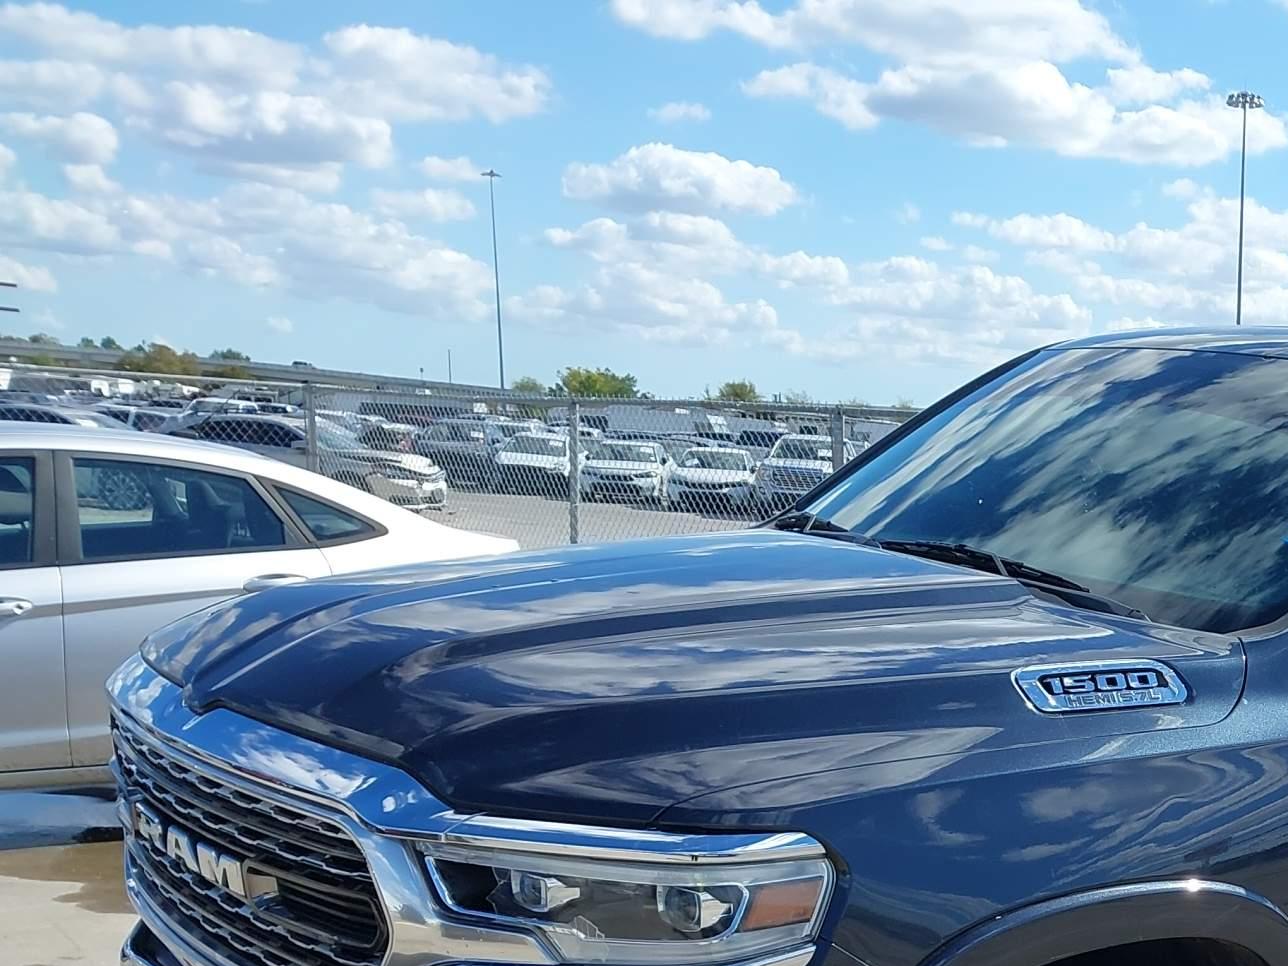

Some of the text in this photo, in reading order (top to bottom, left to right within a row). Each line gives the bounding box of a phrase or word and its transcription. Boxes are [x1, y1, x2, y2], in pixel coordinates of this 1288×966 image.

[1044, 672, 1159, 694] 1500
[1065, 694, 1116, 707] HEMI
[135, 801, 246, 897] RAM
